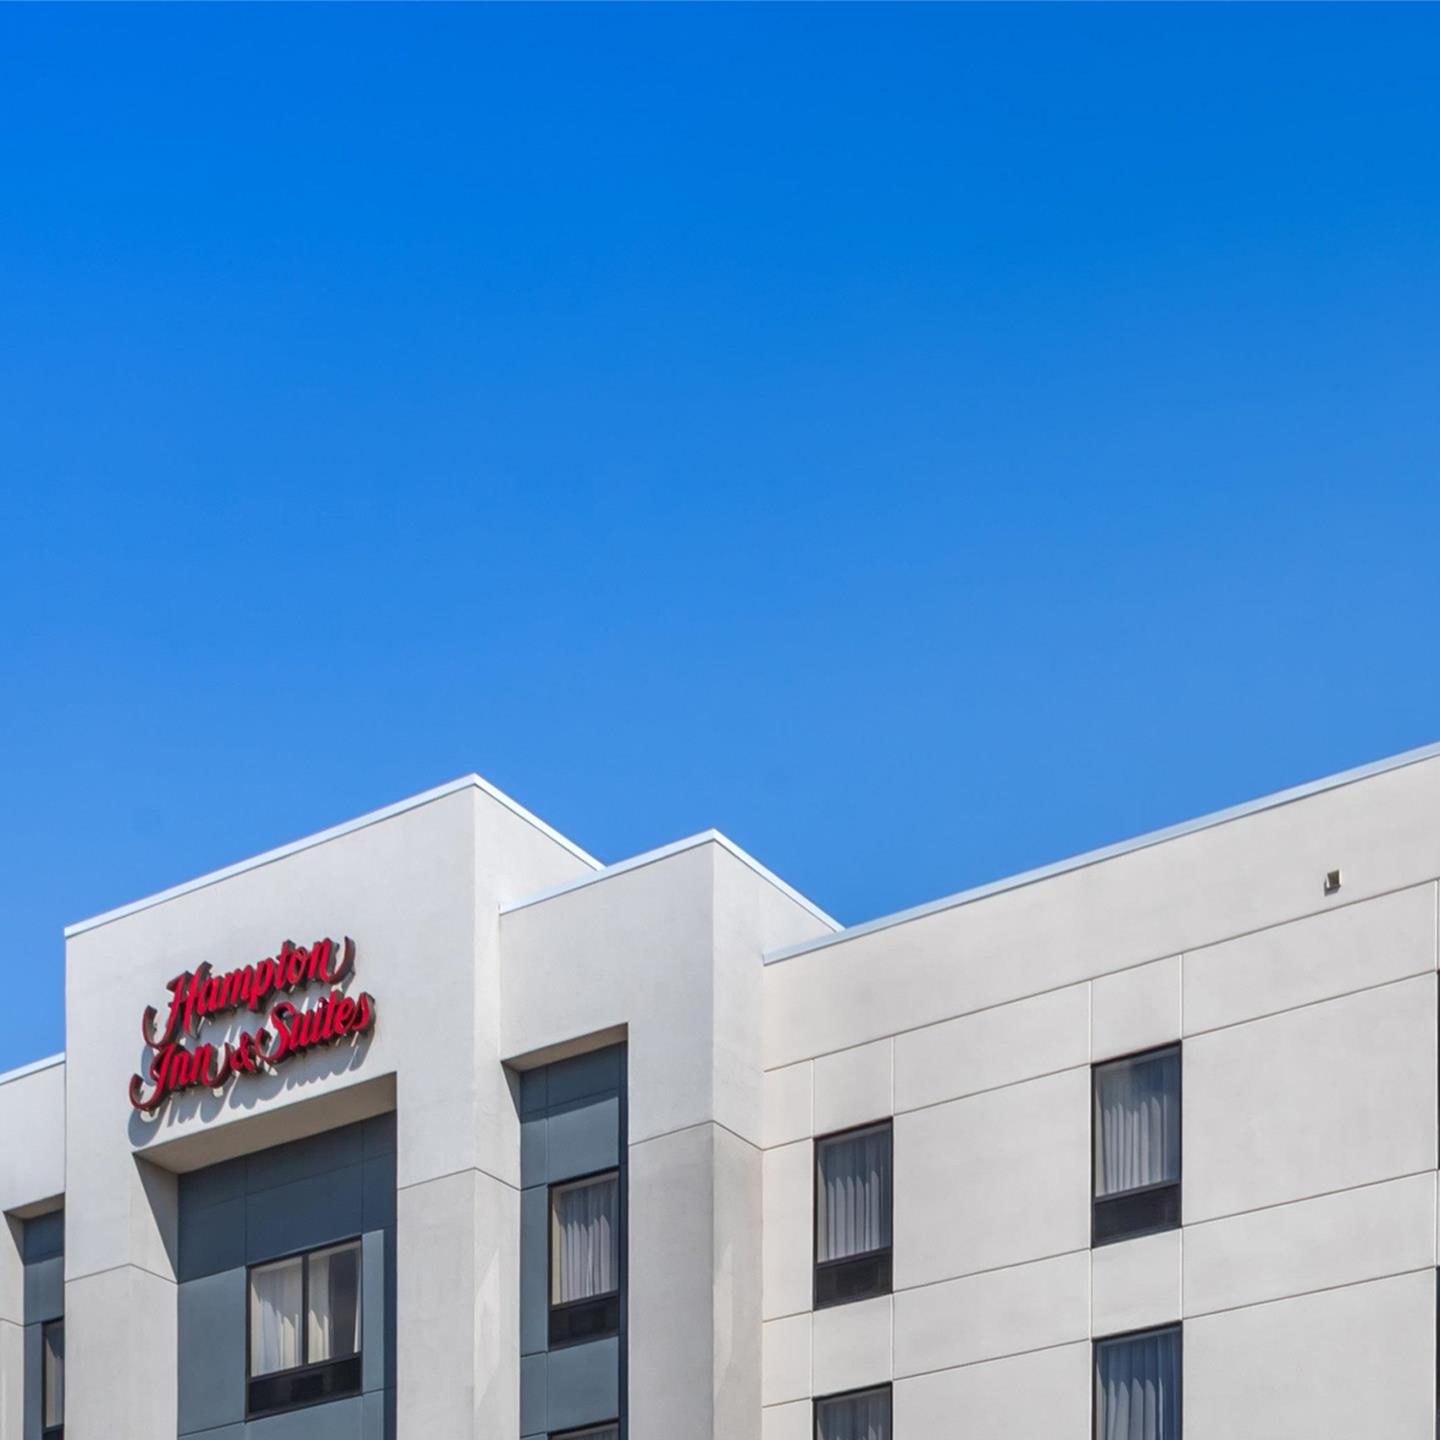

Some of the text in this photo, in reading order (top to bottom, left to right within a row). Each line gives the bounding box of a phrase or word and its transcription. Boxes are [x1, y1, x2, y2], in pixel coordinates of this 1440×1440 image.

[141, 936, 356, 1049] Hampton
[129, 992, 375, 1111] Inn & Suites
